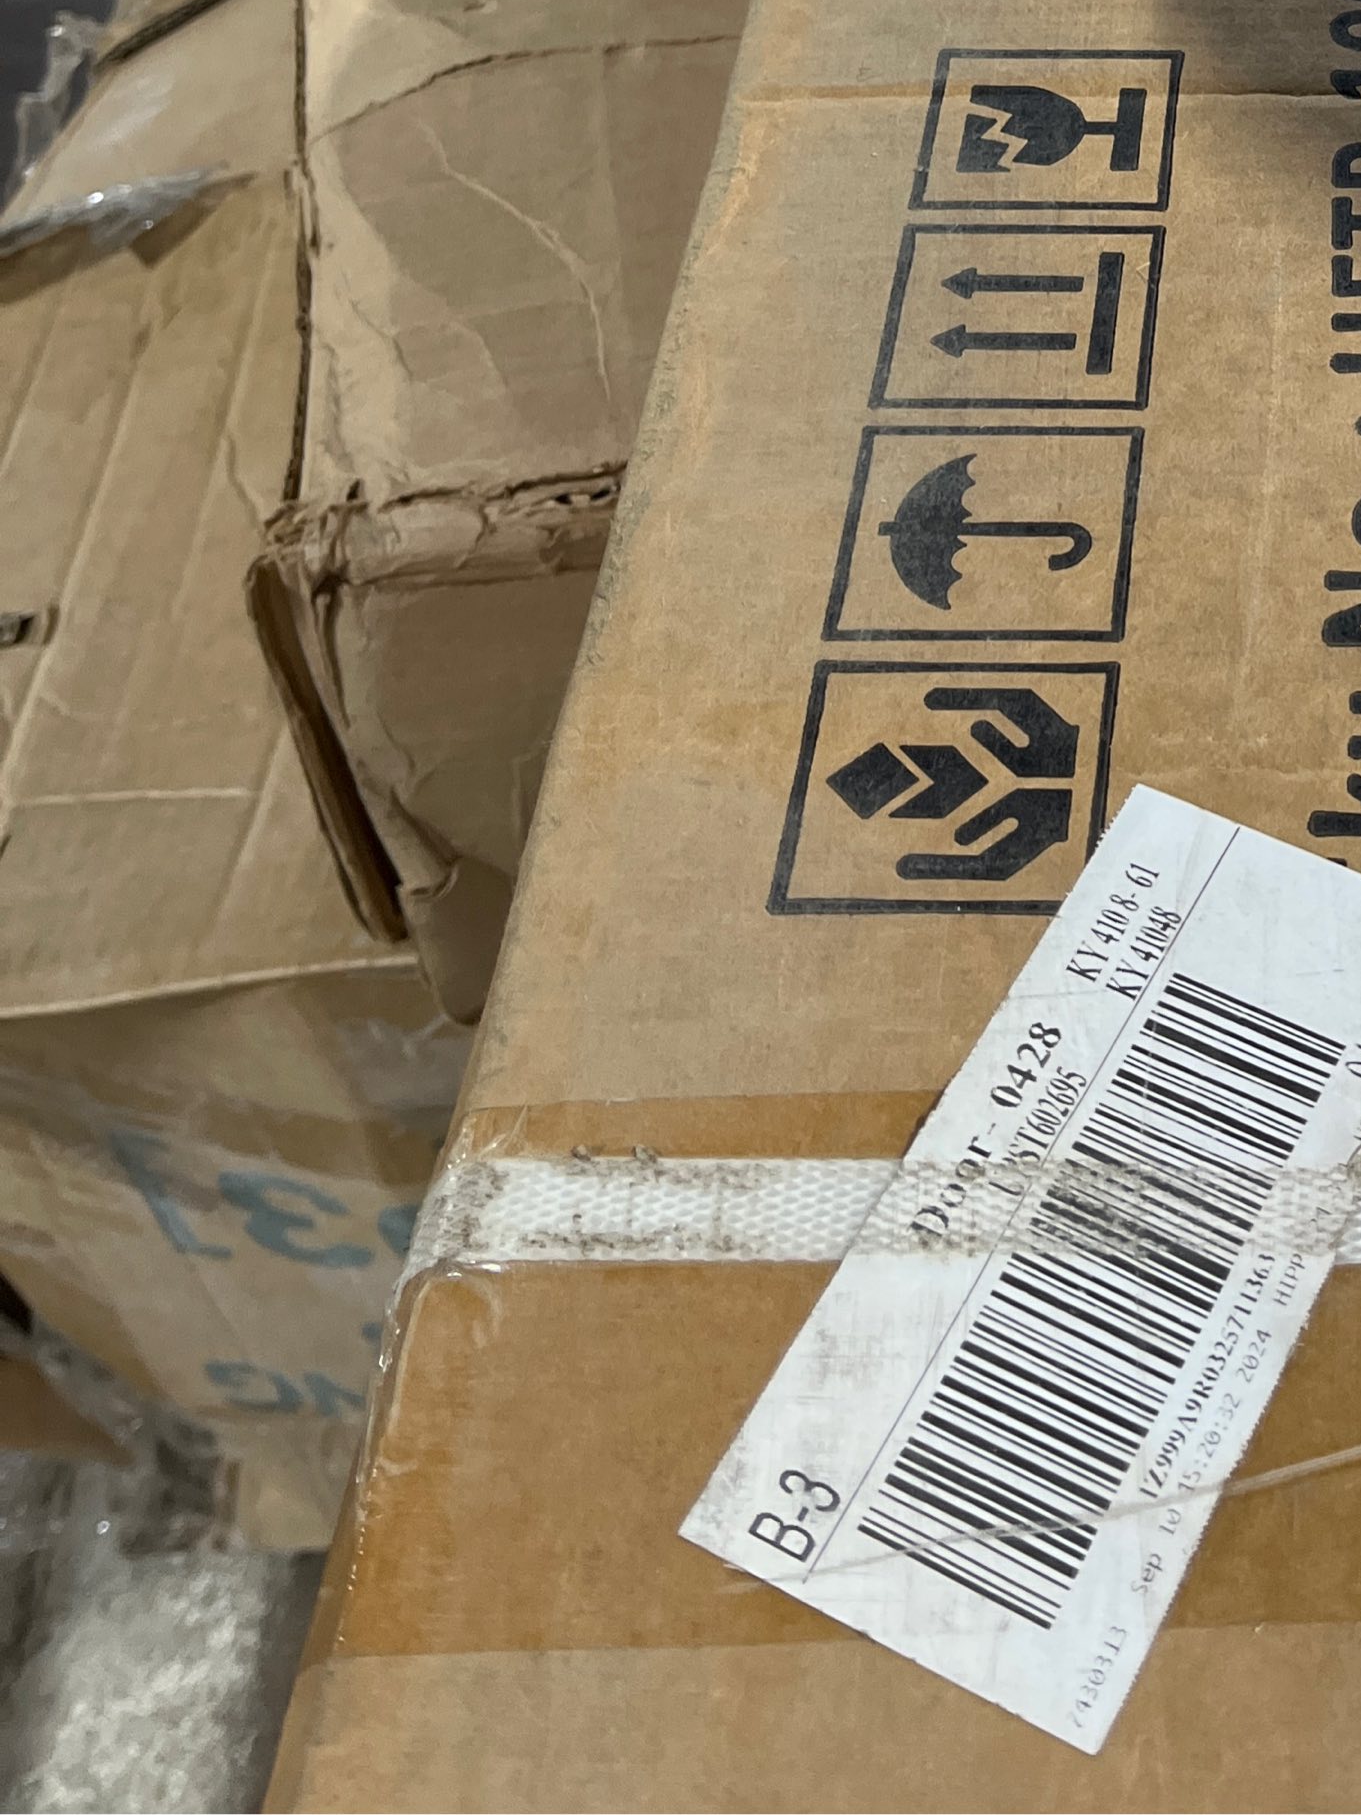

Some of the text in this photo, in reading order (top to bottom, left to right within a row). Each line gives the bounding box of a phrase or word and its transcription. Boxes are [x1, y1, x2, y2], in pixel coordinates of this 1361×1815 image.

[1065, 940, 1110, 984] KY
[1104, 905, 1183, 1002] KY 41048
[989, 1020, 1063, 1109] 0428
[1129, 1552, 1166, 1598] Sep
[1234, 1328, 1274, 1385] 2024
[747, 1470, 842, 1563] B-3
